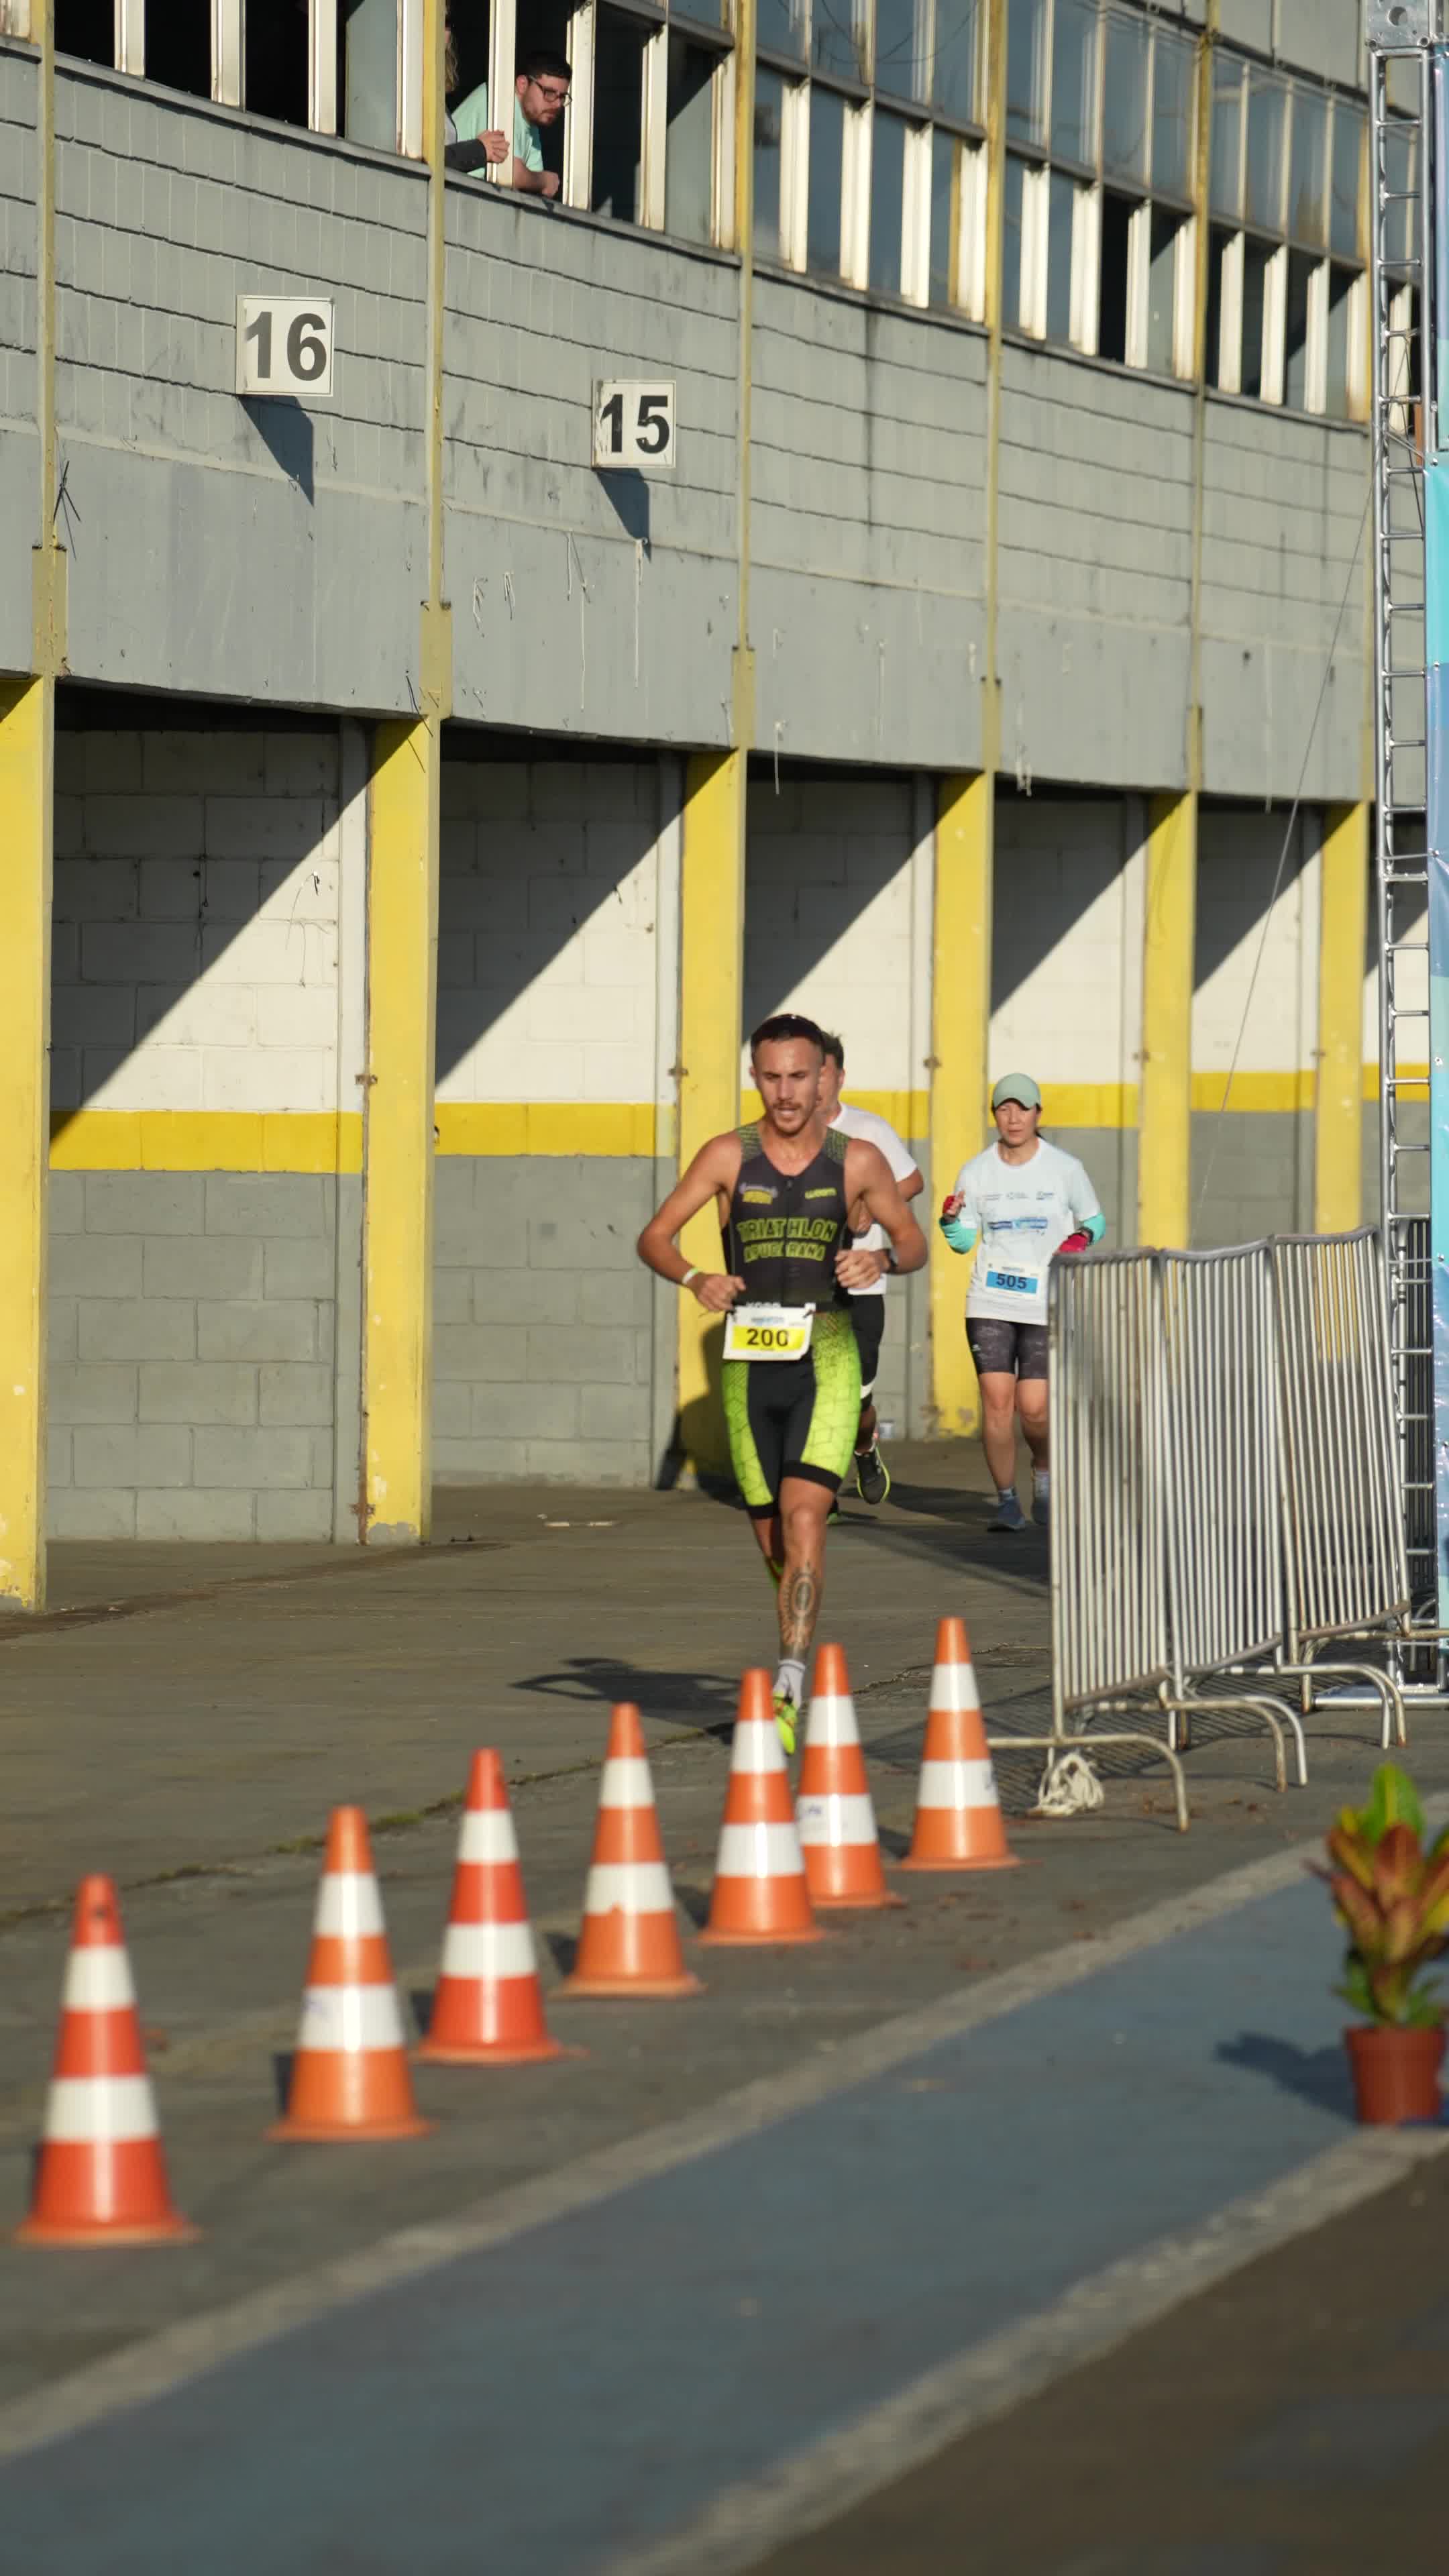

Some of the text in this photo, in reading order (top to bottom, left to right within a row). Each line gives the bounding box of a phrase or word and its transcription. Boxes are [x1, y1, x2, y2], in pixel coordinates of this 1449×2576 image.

[246, 311, 327, 381] 16
[600, 394, 669, 454] 15
[737, 1218, 838, 1242] TRIATHLON
[996, 1273, 1027, 1289] 505
[747, 1328, 789, 1347] 200
